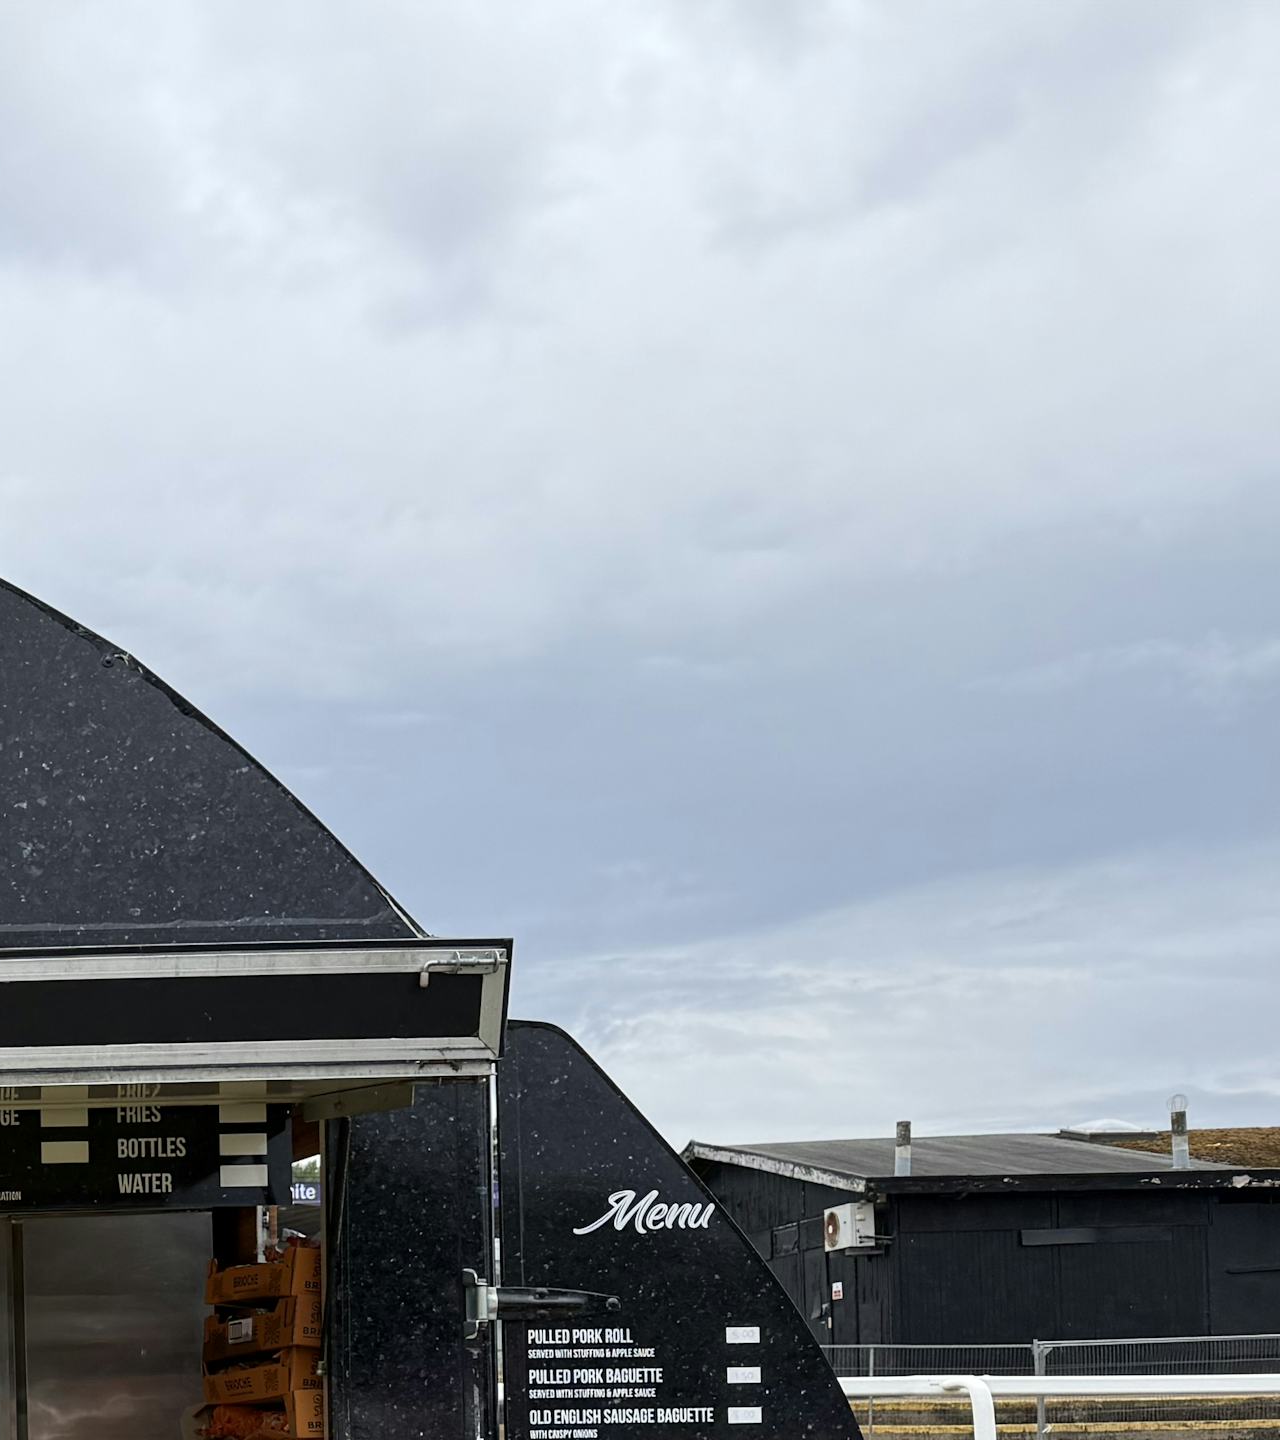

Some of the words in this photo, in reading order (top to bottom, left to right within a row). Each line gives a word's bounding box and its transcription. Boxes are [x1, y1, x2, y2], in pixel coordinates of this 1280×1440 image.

[117, 1137, 185, 1158] BOTTLES
[118, 1173, 172, 1194] WATER
[573, 1189, 715, 1234] Menu
[528, 1329, 570, 1344] PULLED
[572, 1329, 602, 1344] PORK
[605, 1328, 633, 1343] ROLL
[529, 1369, 571, 1384] PULLED
[573, 1369, 603, 1383] PORK
[606, 1368, 663, 1383] BAGUETTE
[530, 1410, 551, 1425] OLD
[554, 1409, 601, 1424] ENGLISH
[604, 1408, 655, 1424] SAUSAGE
[657, 1407, 714, 1423] BAGUETTE
